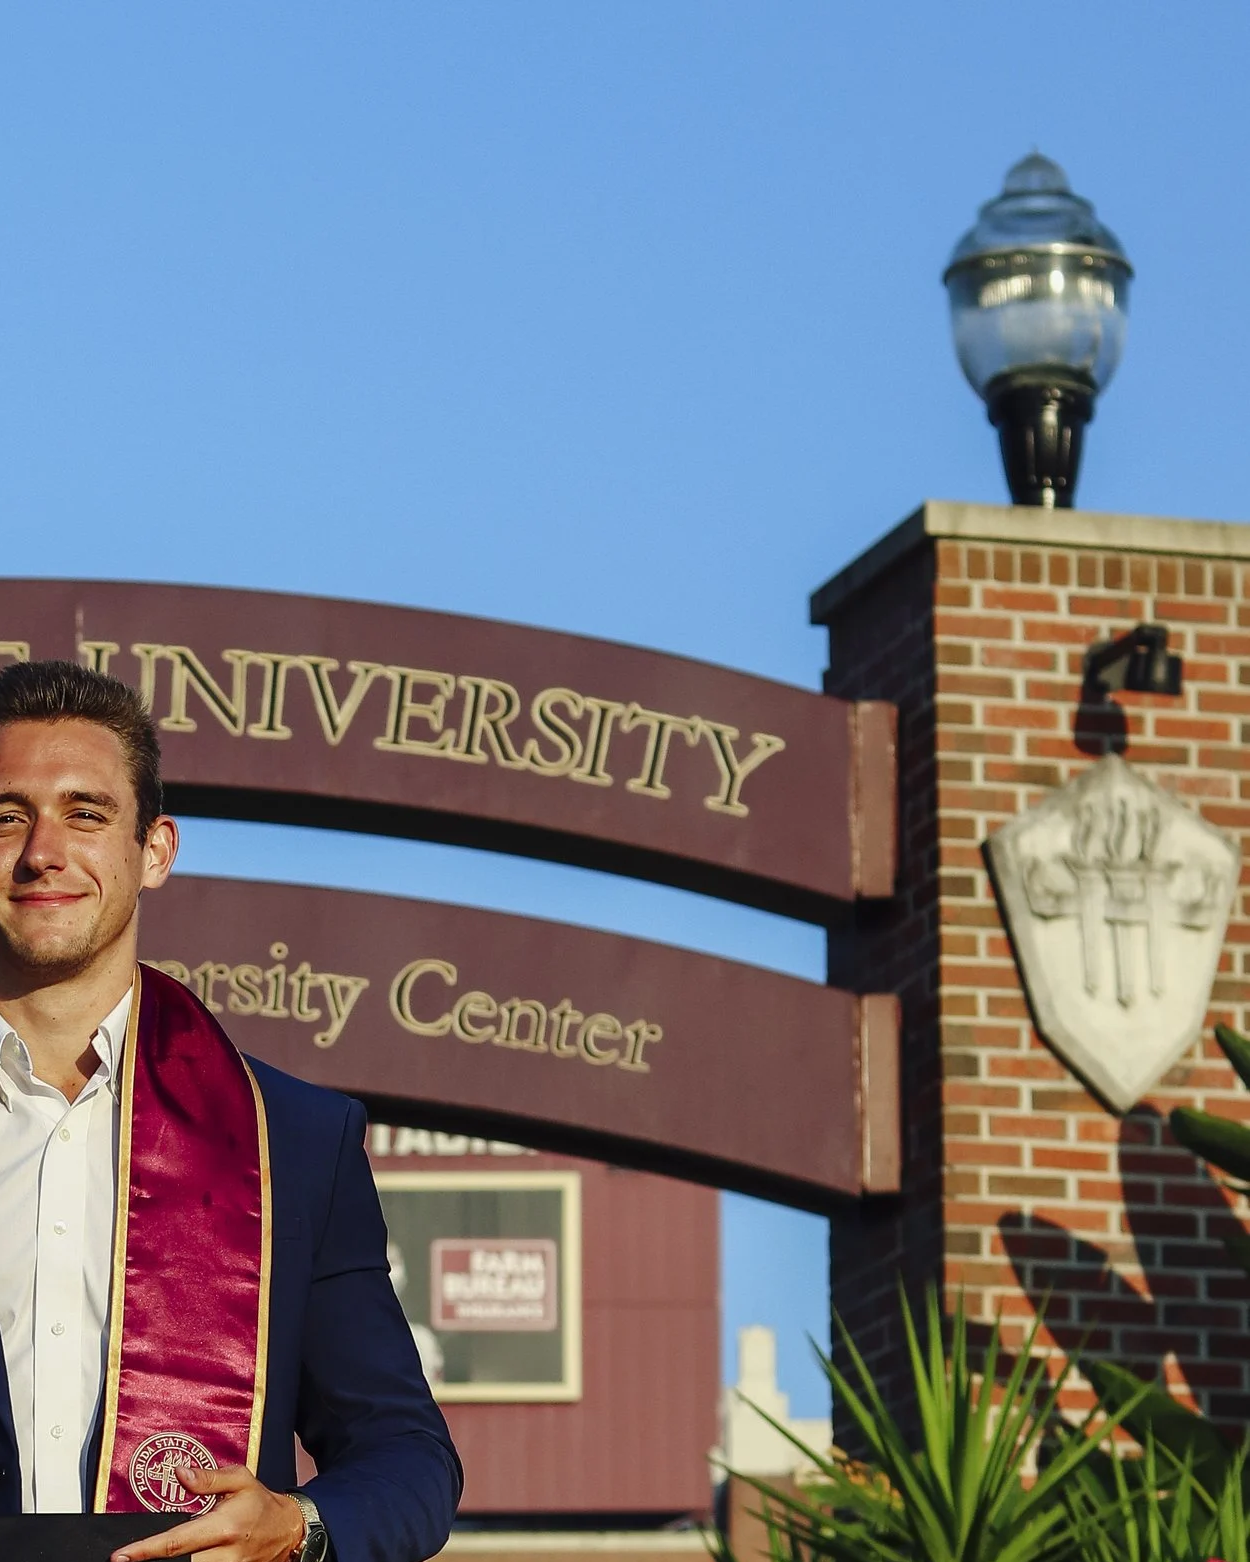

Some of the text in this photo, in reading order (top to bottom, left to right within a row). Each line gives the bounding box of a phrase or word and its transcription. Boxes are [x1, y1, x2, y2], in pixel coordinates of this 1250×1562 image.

[388, 958, 664, 1075] Center
[135, 1446, 156, 1493] FLORIDA
[155, 1437, 189, 1450] STATE
